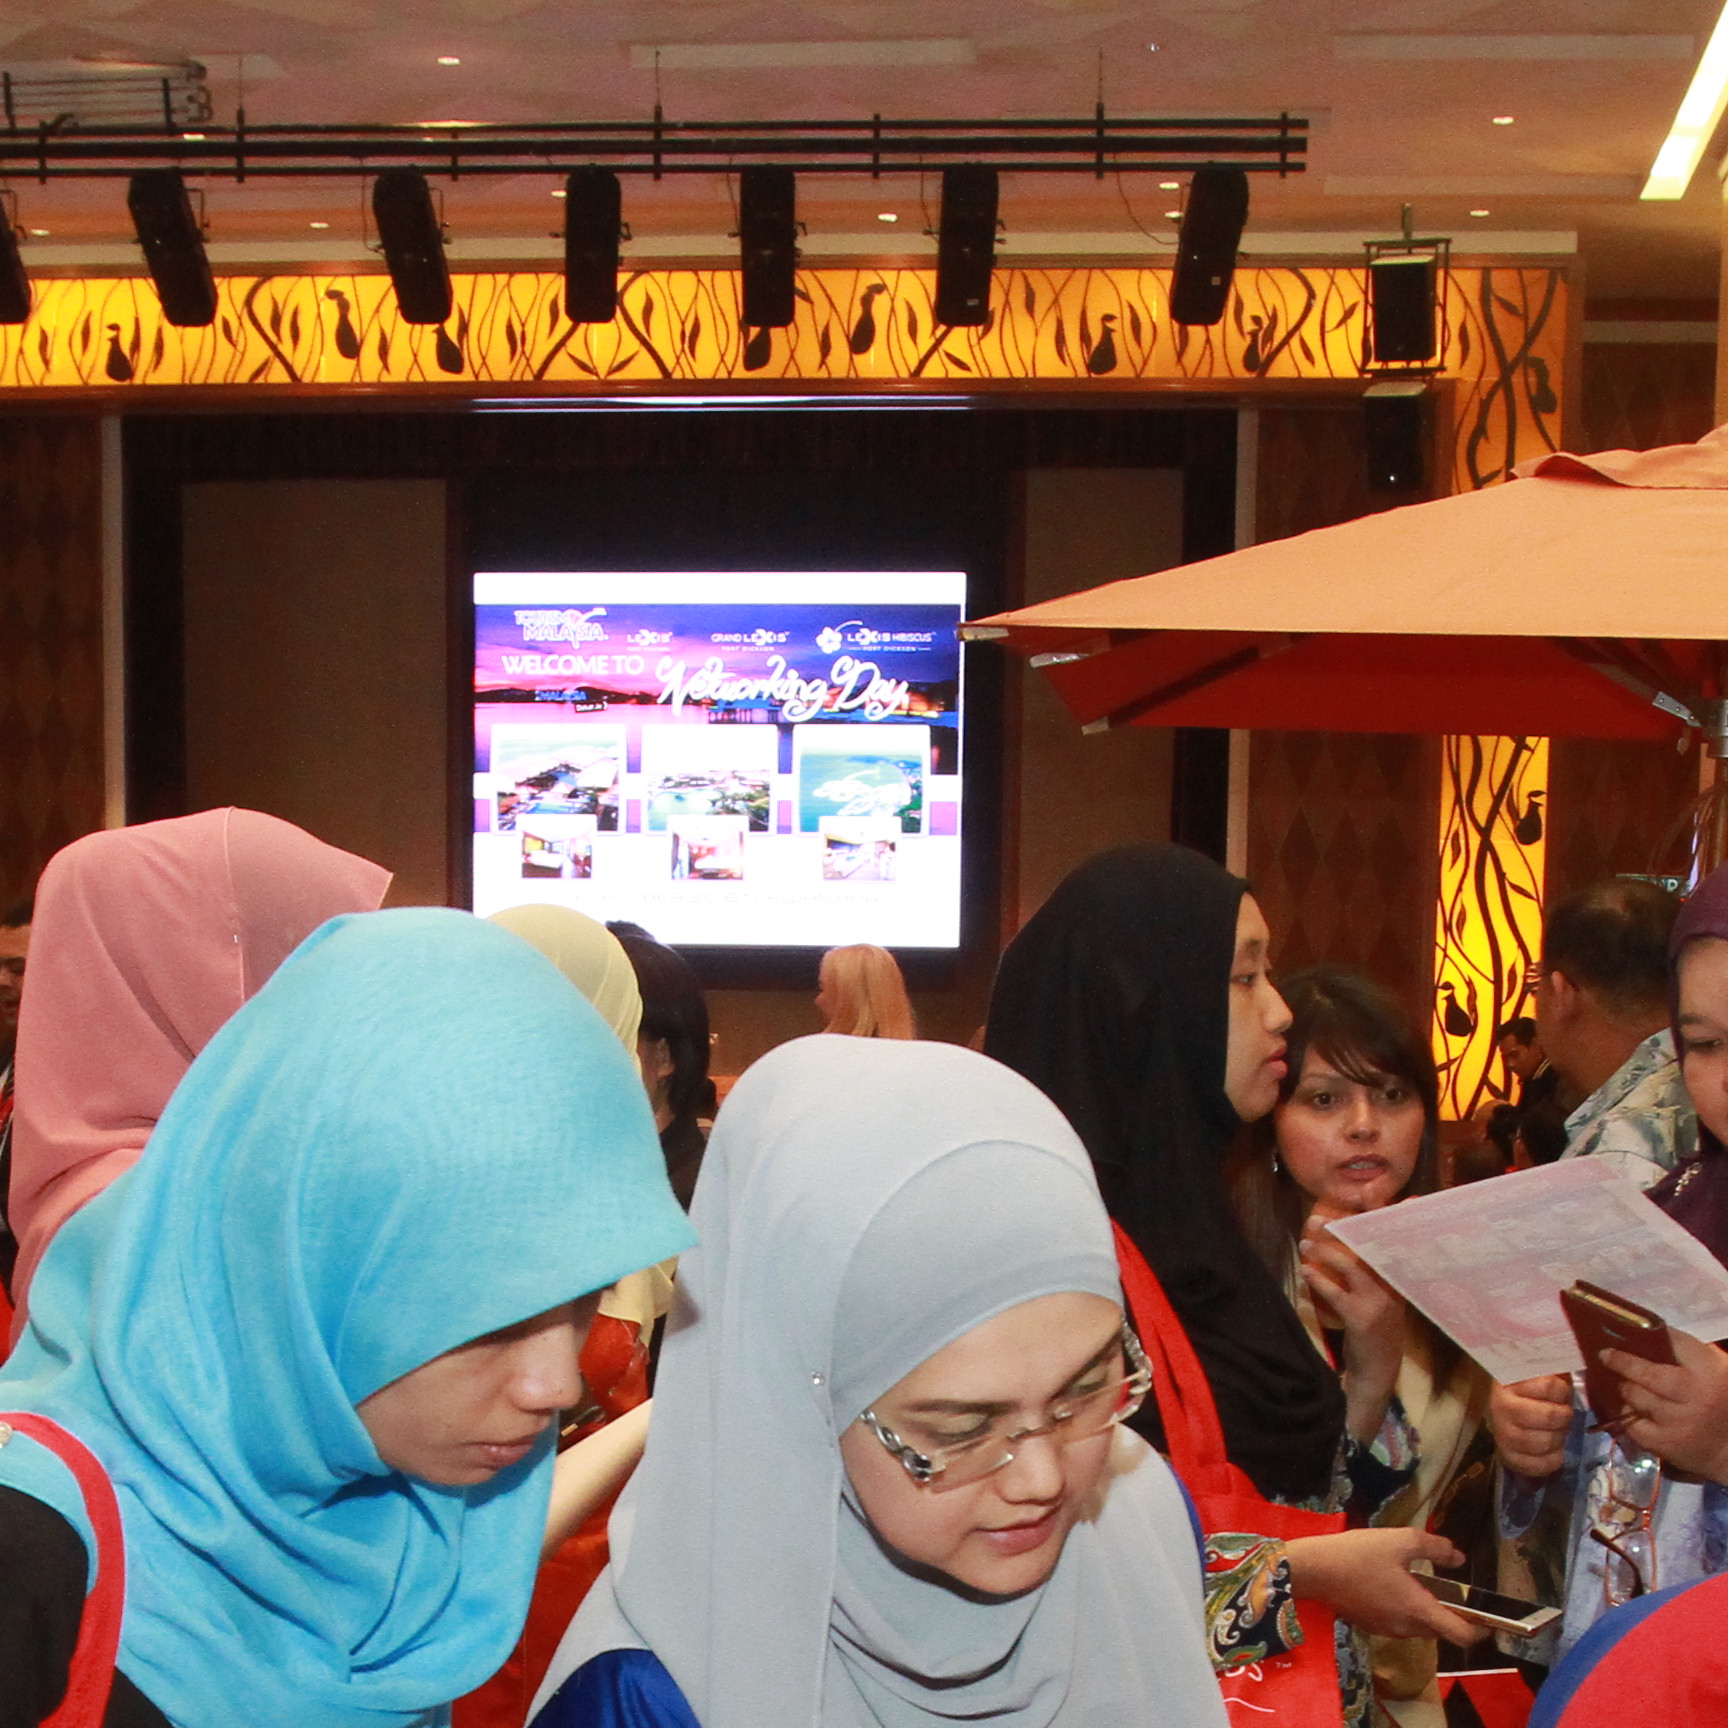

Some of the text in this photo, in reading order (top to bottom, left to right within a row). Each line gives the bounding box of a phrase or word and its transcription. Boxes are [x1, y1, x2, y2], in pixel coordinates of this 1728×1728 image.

[710, 633, 741, 643] GRAND
[891, 631, 933, 642] HIBISCUS
[501, 654, 645, 675] WELCOME TO
[655, 654, 828, 723] Networking
